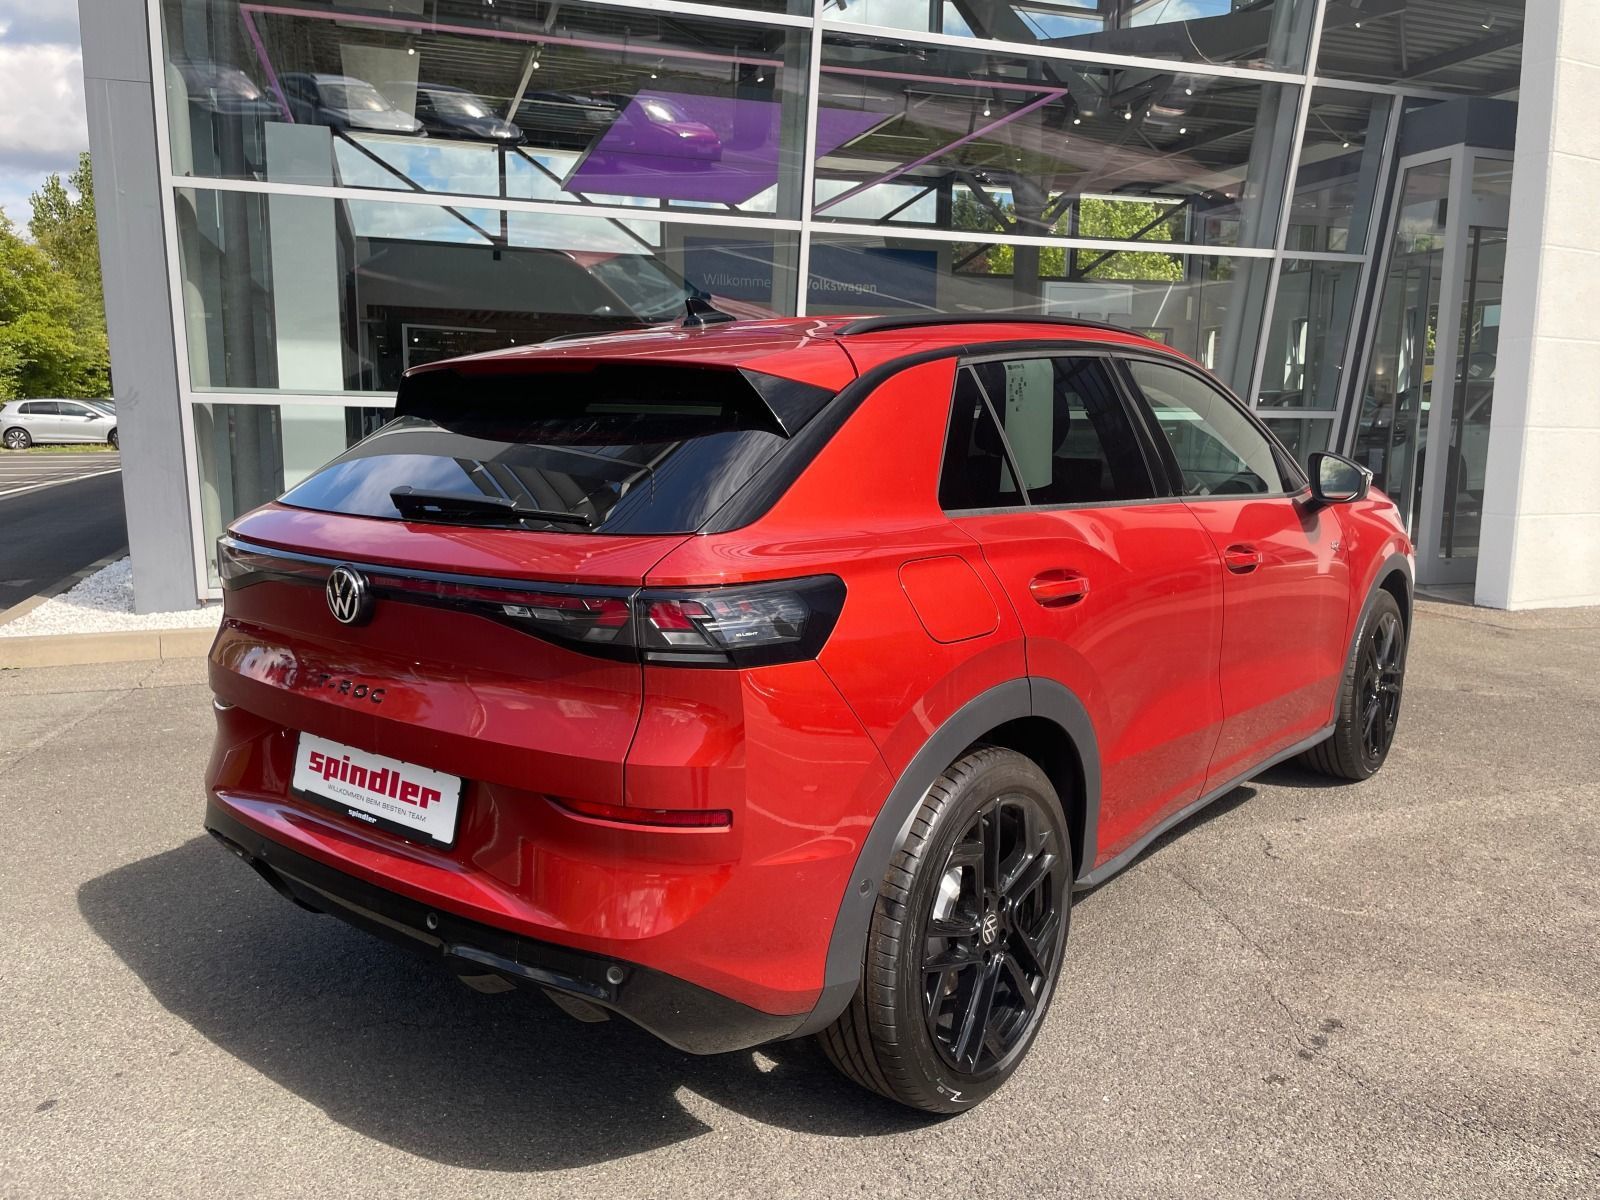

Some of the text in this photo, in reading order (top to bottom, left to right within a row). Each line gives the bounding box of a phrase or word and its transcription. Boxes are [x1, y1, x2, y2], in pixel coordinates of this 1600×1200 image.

[703, 271, 771, 288] Willkomme
[319, 674, 386, 704] T-ROC
[309, 751, 441, 809] spindler
[327, 783, 427, 823] WILLKOMMEN BEIM BESTEN TEAM
[348, 809, 377, 824] spindler
